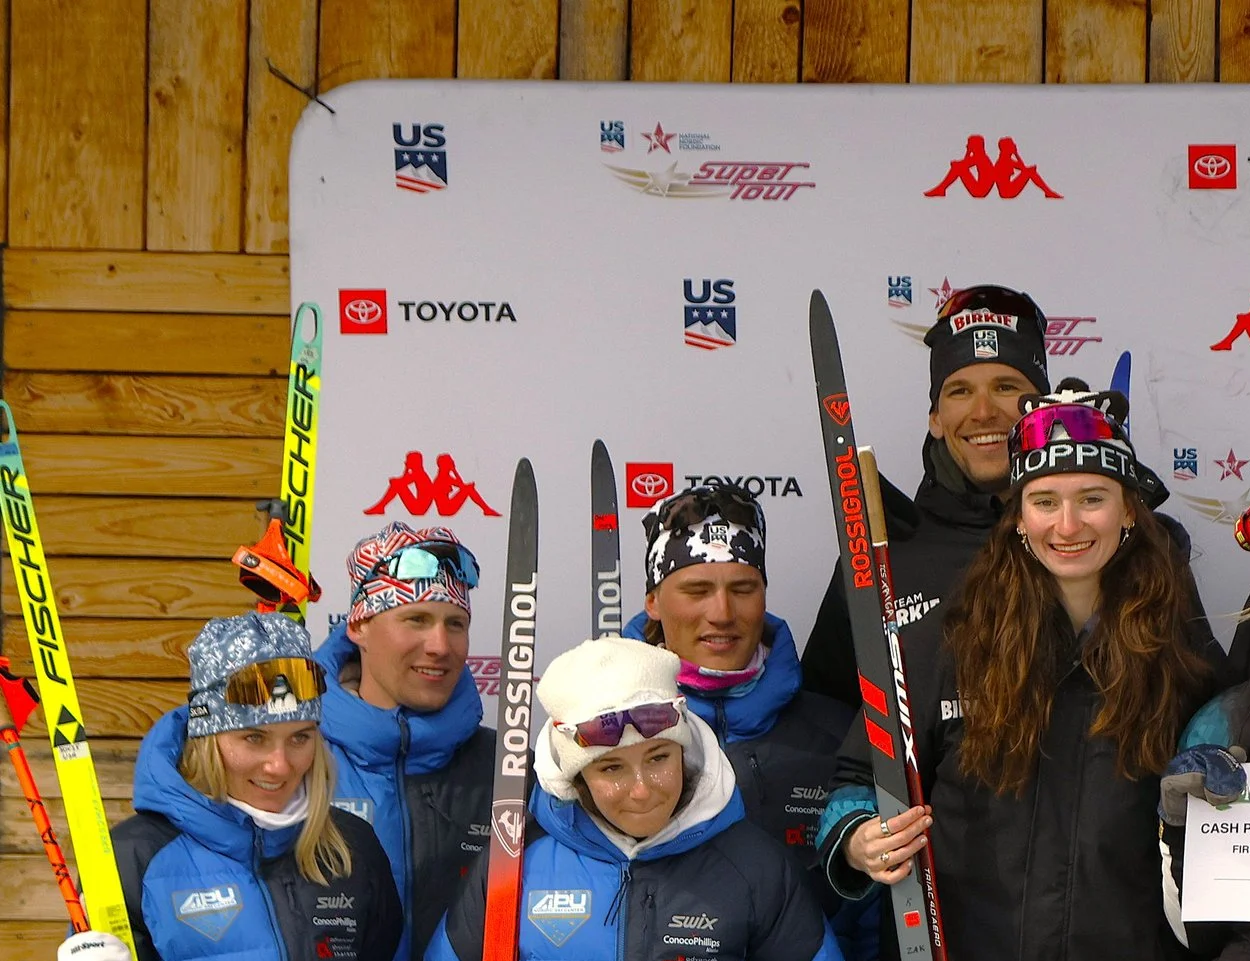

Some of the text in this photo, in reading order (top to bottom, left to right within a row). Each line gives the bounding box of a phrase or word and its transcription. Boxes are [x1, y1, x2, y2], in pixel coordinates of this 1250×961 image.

[600, 120, 625, 132] US
[392, 122, 447, 147] US
[888, 275, 912, 287] US
[683, 278, 736, 303] US
[397, 301, 517, 323] TOYOTA
[953, 311, 1013, 332] BIRKIE
[974, 330, 997, 340] US
[1173, 447, 1198, 460] US
[834, 445, 874, 589] ROSSIGNOL
[709, 525, 727, 535] US
[1, 465, 68, 686] FISCHER
[501, 571, 539, 778] ROSSIGNOL
[1200, 823, 1240, 835] CASH
[312, 916, 357, 927] ConocoPhillips
[663, 934, 721, 949] ConocoPhillips
